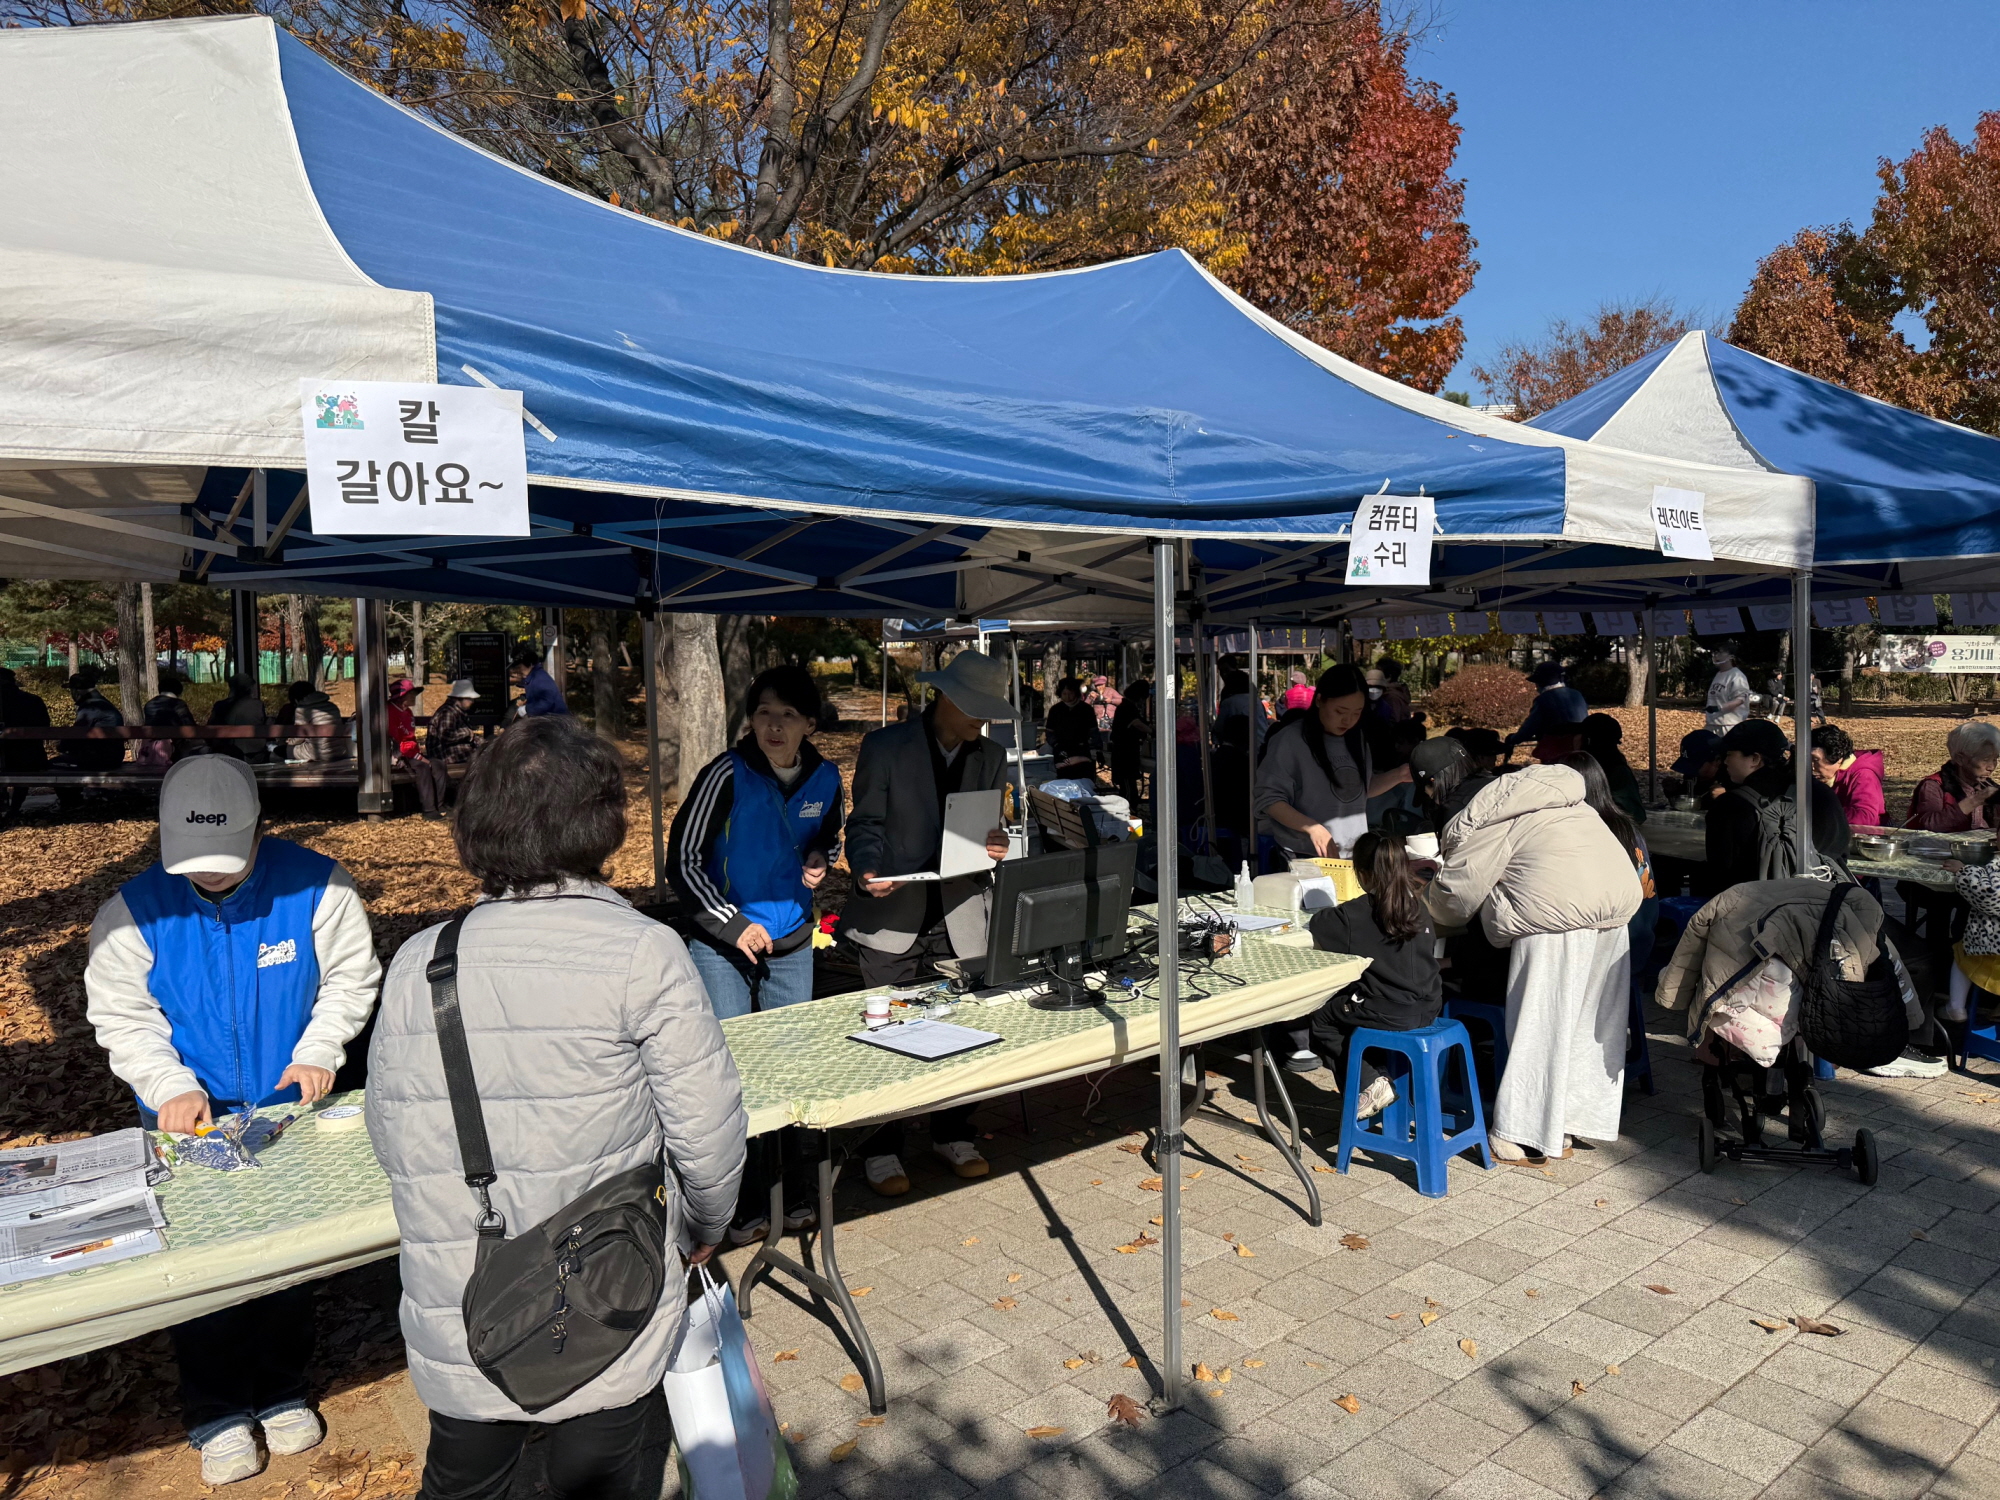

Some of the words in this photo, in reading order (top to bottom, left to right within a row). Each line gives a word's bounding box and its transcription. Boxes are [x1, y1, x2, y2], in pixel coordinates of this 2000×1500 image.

[399, 400, 440, 444] 칼
[336, 460, 503, 505] 갈아요~
[1368, 505, 1417, 532] 컴퓨터
[1656, 507, 1702, 530] 레진아트
[1374, 541, 1406, 567] 수리
[1951, 648, 1994, 661] 용기내
[186, 810, 227, 826] Jeep
